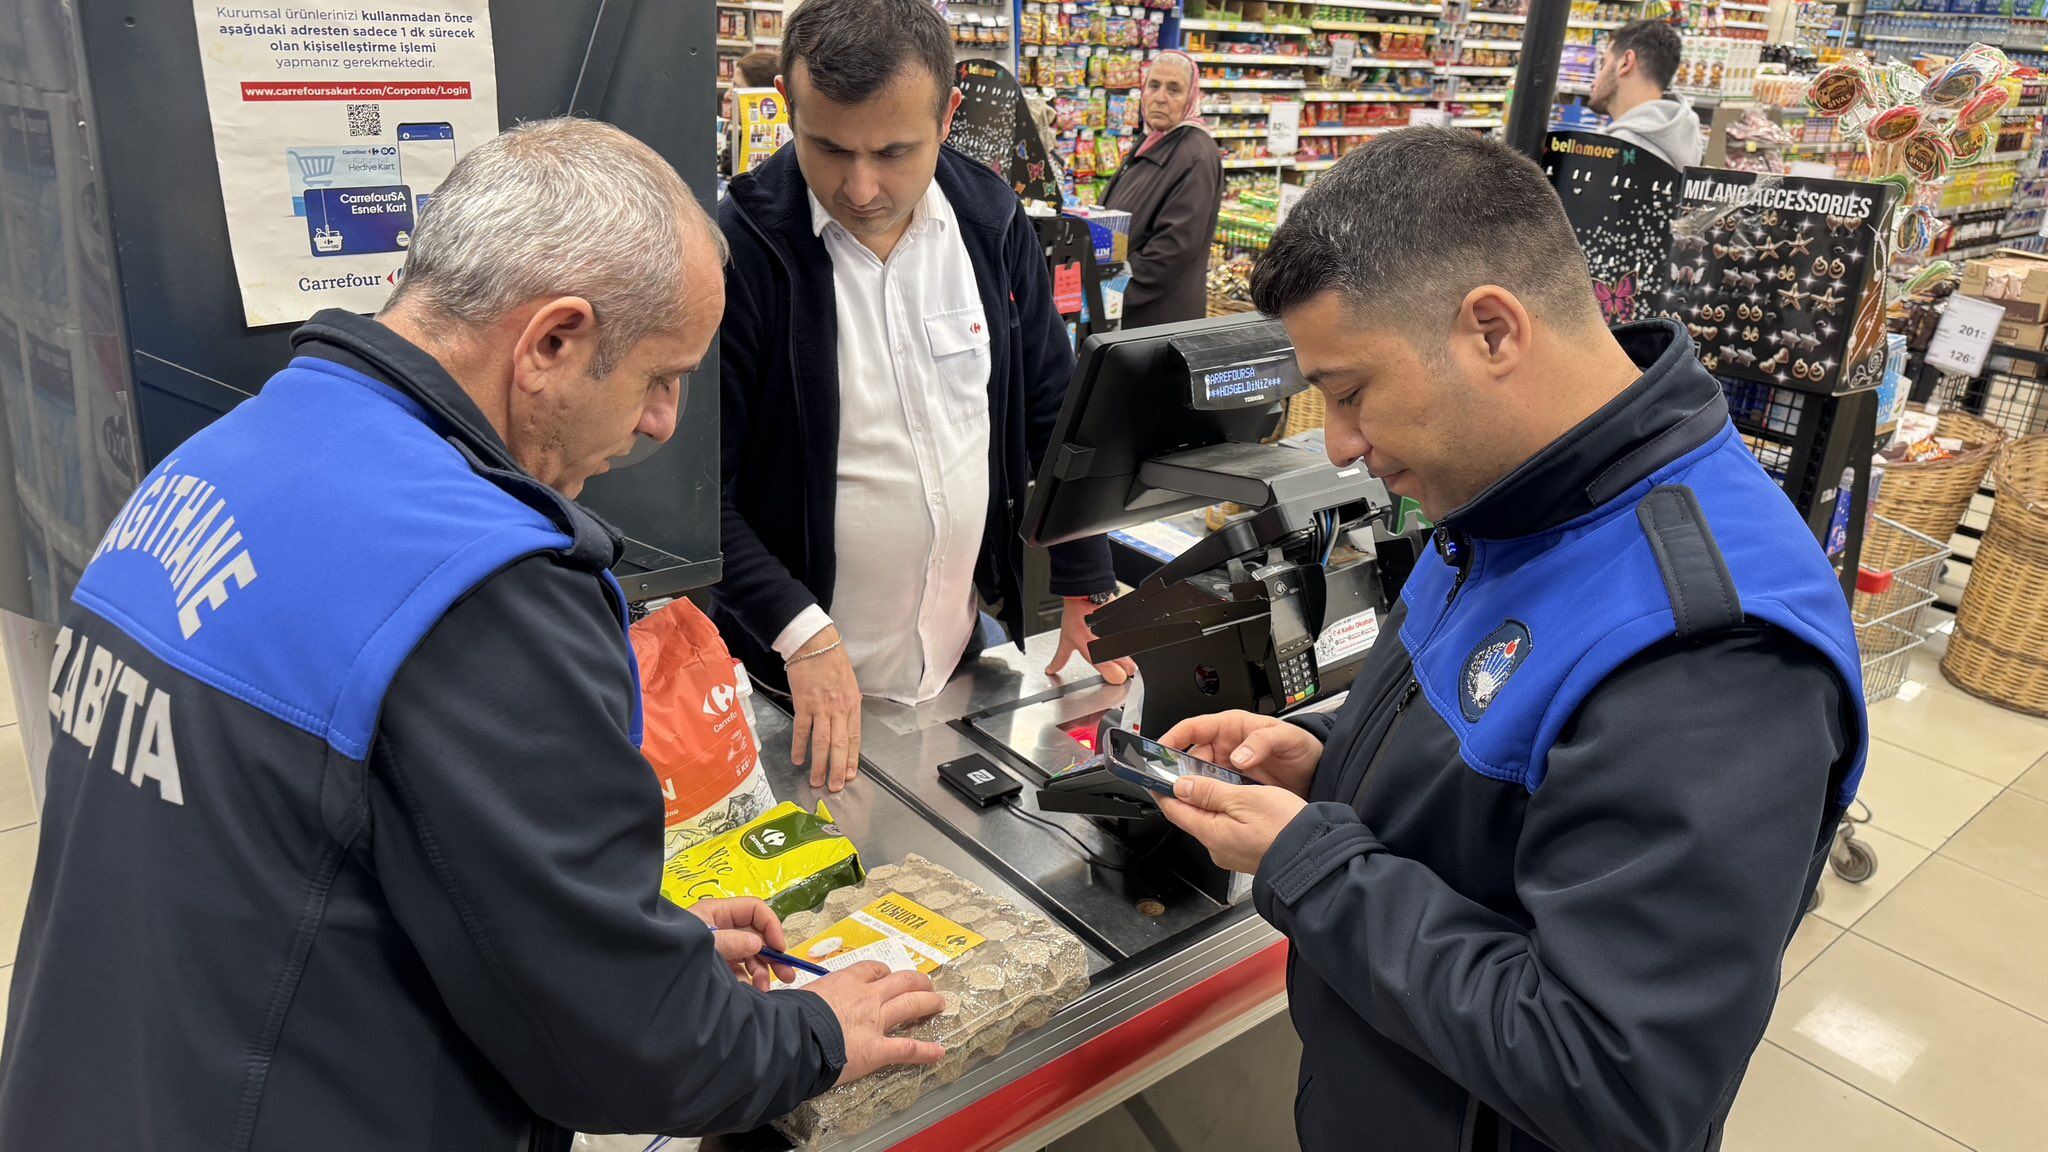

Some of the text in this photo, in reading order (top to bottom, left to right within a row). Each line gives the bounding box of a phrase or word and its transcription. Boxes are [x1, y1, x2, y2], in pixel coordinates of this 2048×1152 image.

[217, 7, 473, 23] Kurumsal ürünlerinizi kullanmadan önce
[220, 24, 475, 38] aşağıdaki adresten sadece 1 dk sürecek
[270, 40, 436, 54] olan kişiselleştirme işlemi
[275, 57, 435, 69] yapmanız gerekmektedir.
[245, 85, 469, 97] www.carrefoursakart.com/Corporate/Login
[1551, 136, 1615, 159] bellamore
[378, 163, 396, 171] Kart
[340, 191, 406, 204] CarrefourSA
[1750, 186, 1873, 219] ACCESSORIES
[351, 202, 407, 215] Esnek Kart
[299, 272, 382, 292] Carrefour
[90, 458, 257, 641] AĞITHANE
[713, 711, 738, 733] Carrefo
[875, 899, 929, 930] YUMURTA
